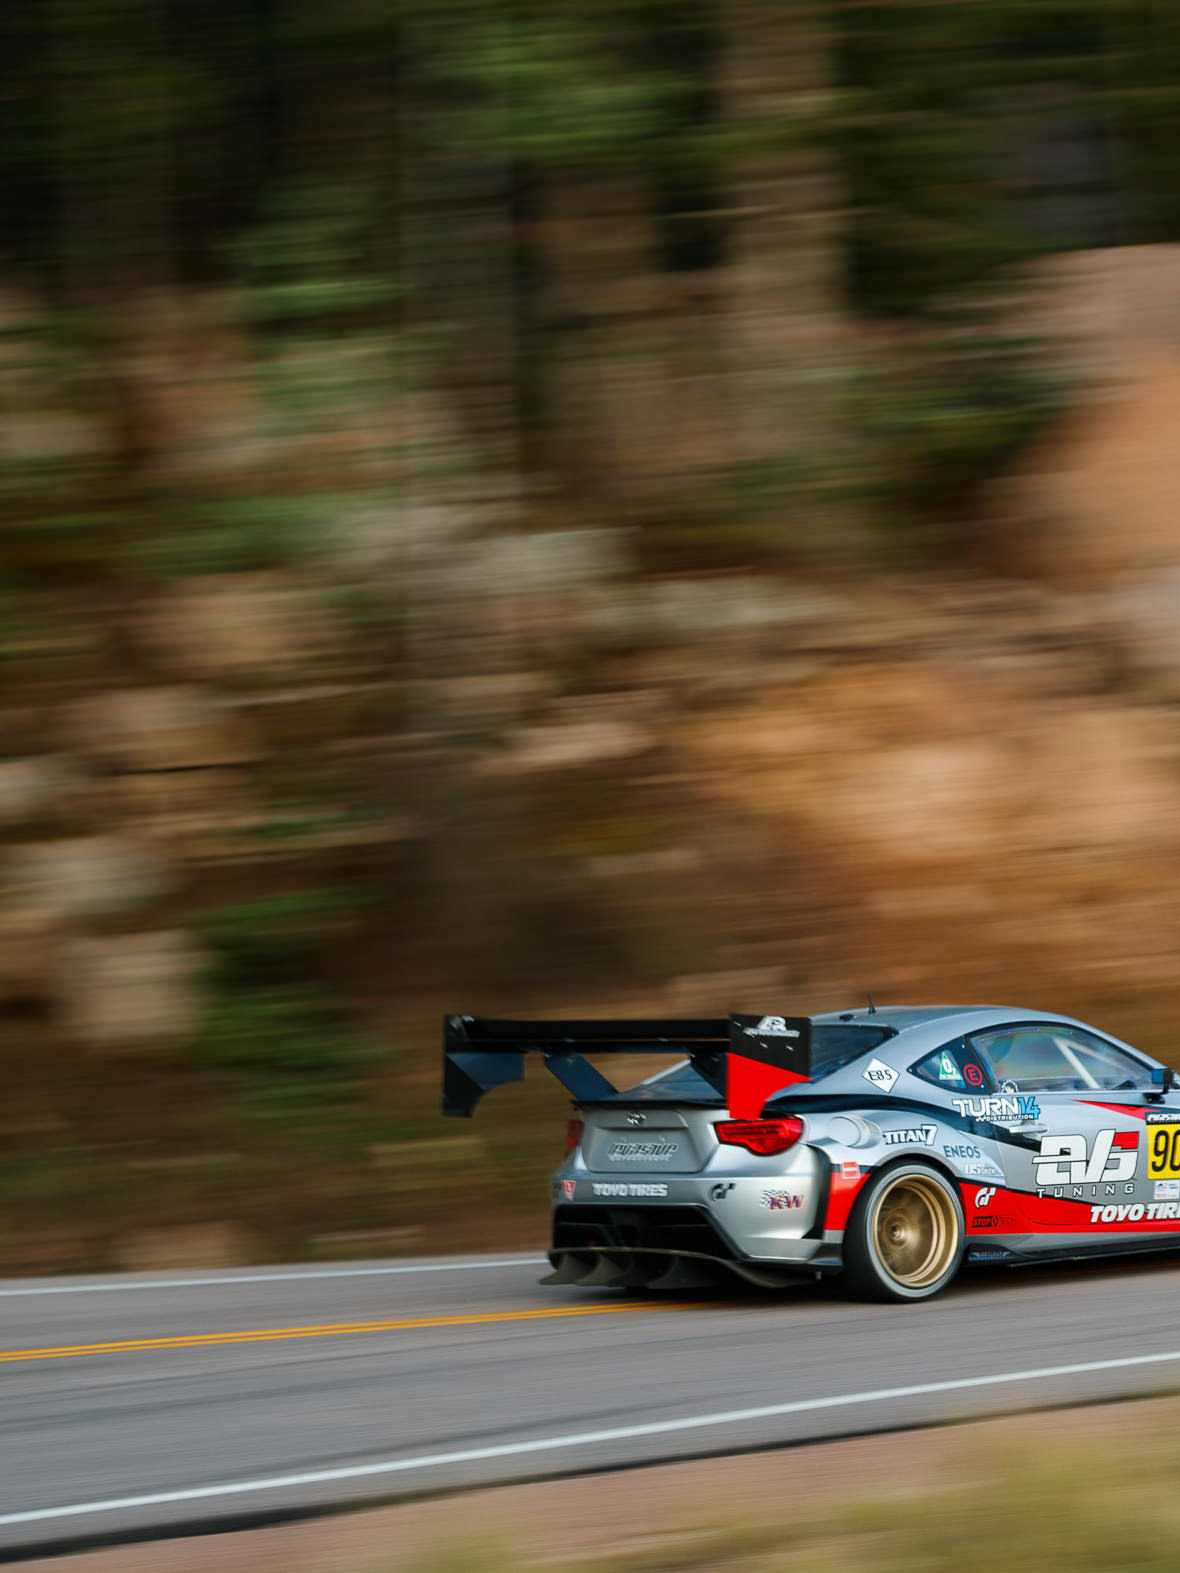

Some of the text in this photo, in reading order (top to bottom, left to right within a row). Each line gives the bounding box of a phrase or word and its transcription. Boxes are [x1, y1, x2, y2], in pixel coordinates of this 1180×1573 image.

[868, 1070, 893, 1082] E85
[952, 1096, 1041, 1120] TURN14
[943, 1145, 981, 1159] ENEOS
[592, 1183, 668, 1197] TOYO TIRES
[1036, 1183, 1134, 1199] TUNING
[1090, 1203, 1145, 1224] TOYO
